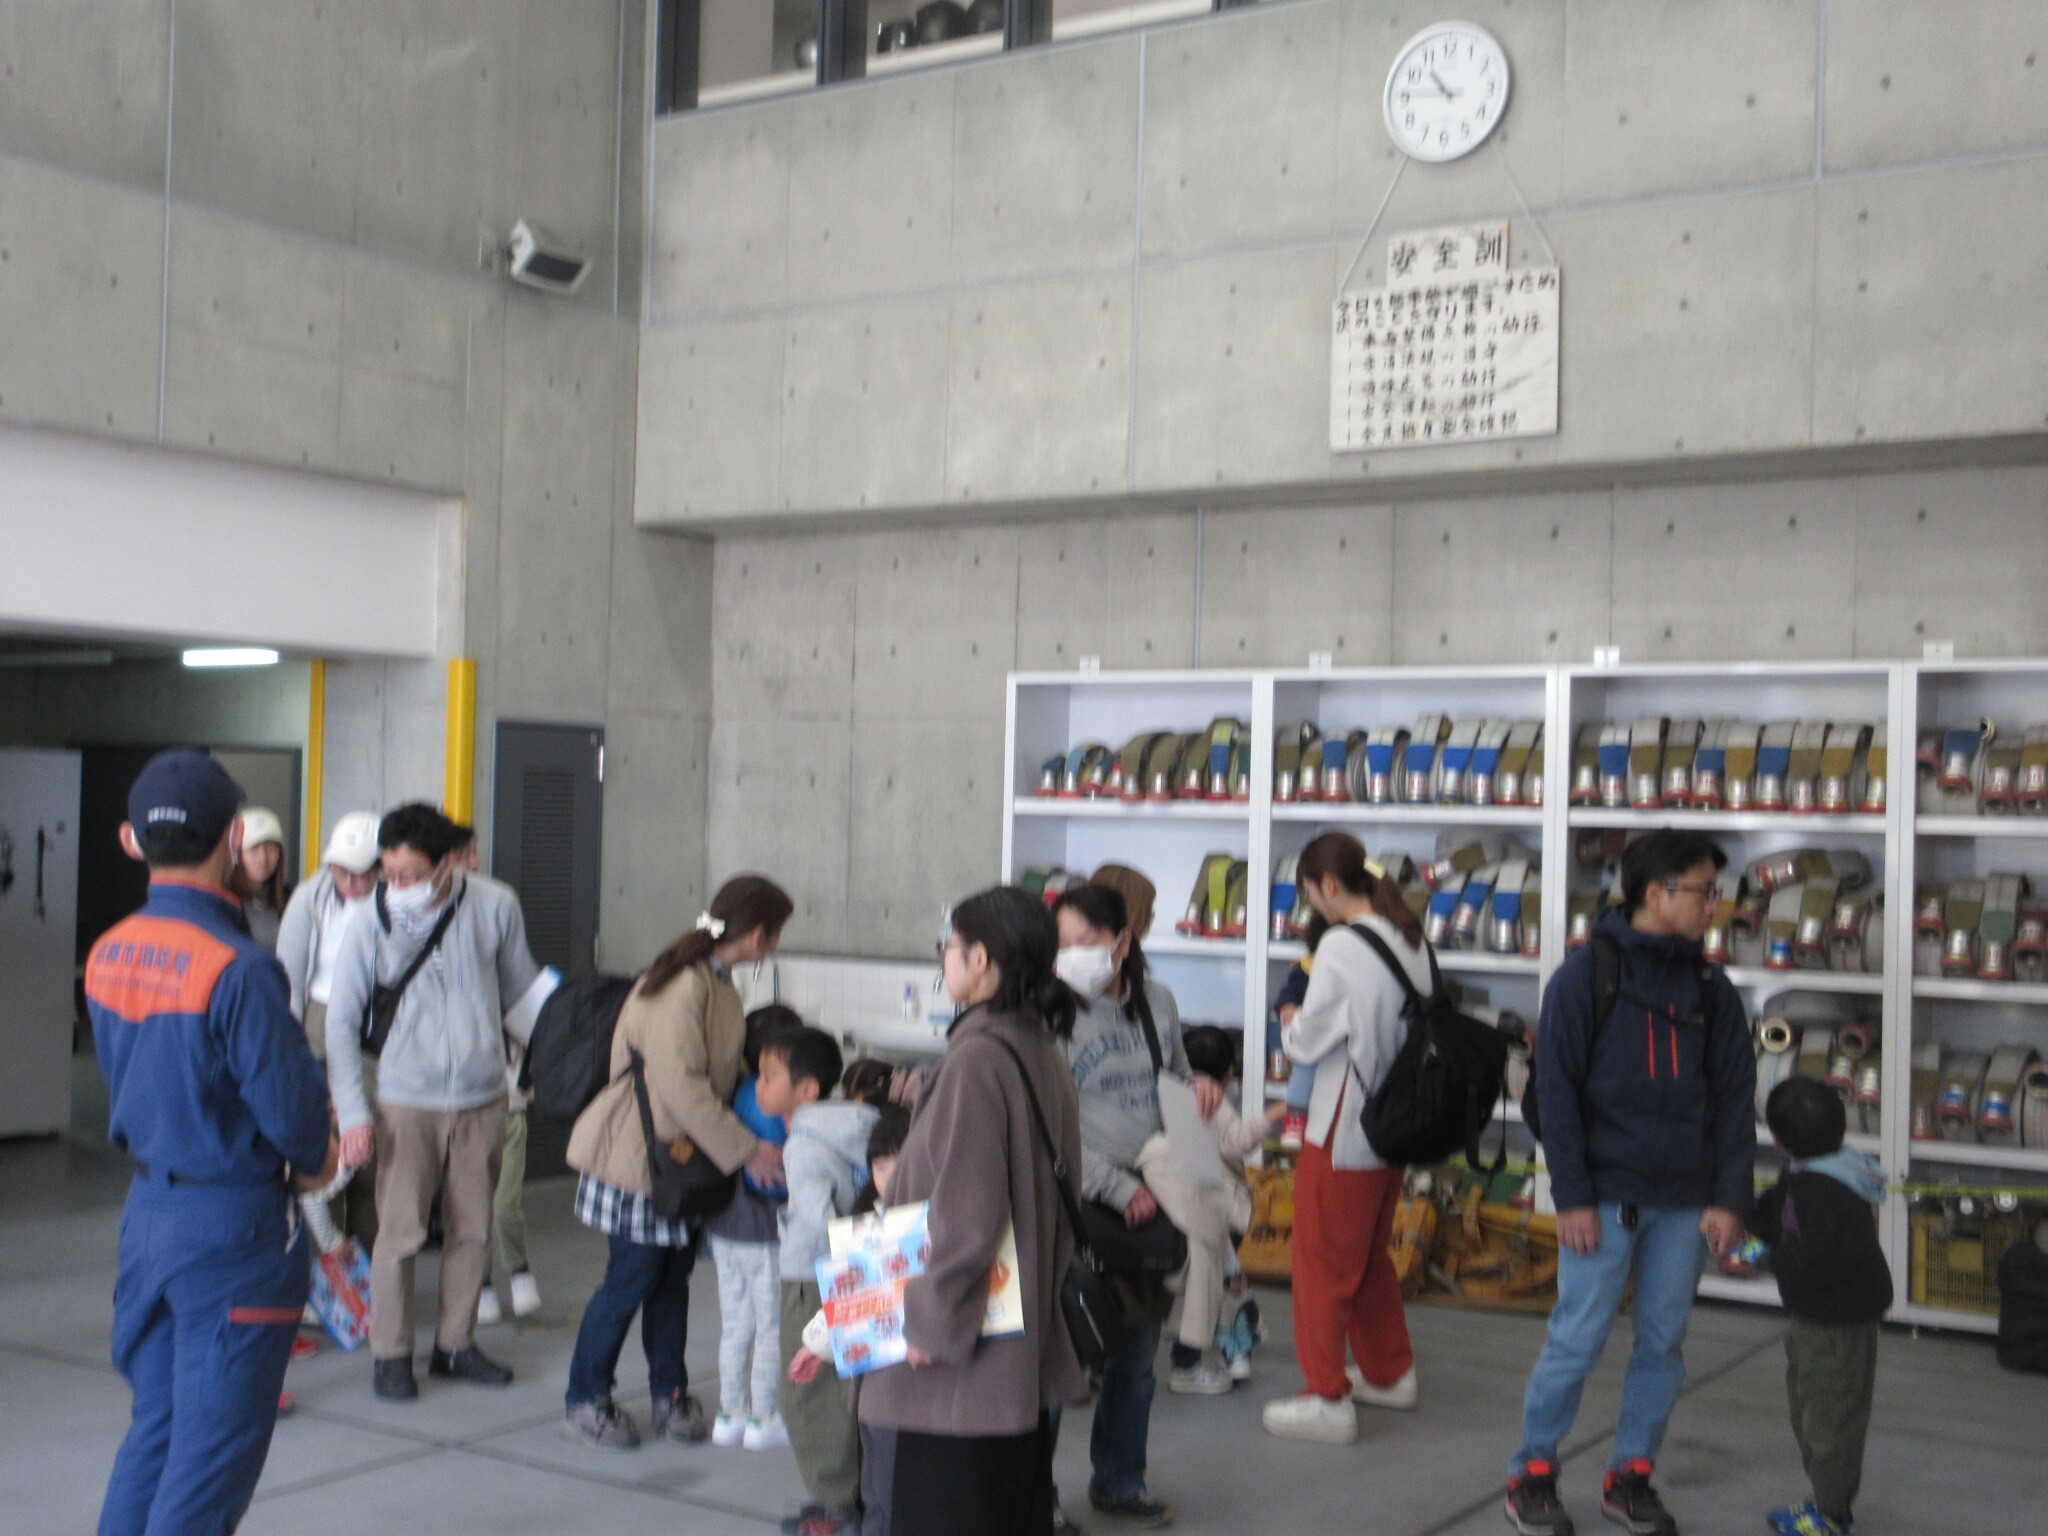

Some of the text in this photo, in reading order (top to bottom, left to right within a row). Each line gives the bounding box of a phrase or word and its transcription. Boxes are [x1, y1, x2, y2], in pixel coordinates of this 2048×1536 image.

[1423, 50, 1434, 65] 11
[1443, 41, 1457, 58] 12
[1480, 57, 1490, 75] 2
[1408, 67, 1422, 85] 10
[1486, 81, 1495, 97] 3
[1400, 90, 1410, 108] 9
[1405, 112, 1415, 129] 8
[1476, 103, 1485, 120] 4
[1421, 124, 1429, 143] 7
[1439, 129, 1449, 147] 6
[1391, 231, 1503, 278] 安全訓
